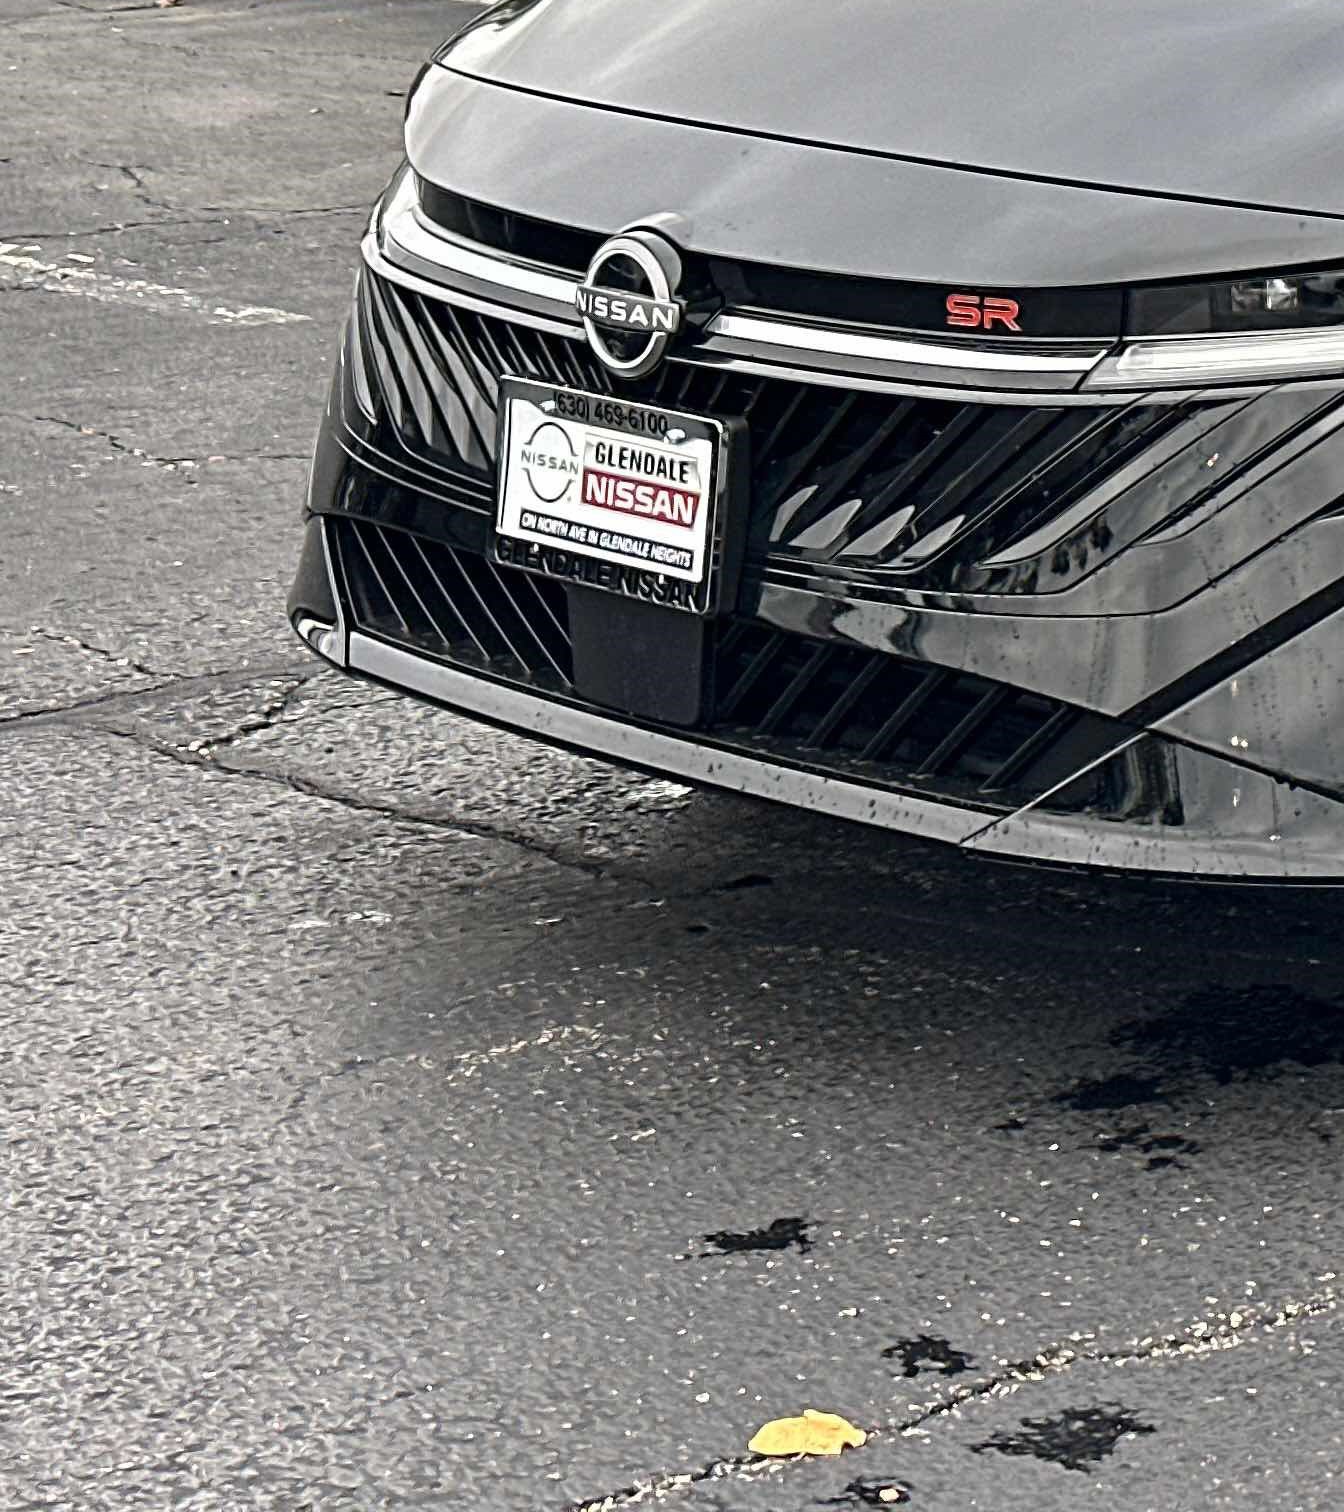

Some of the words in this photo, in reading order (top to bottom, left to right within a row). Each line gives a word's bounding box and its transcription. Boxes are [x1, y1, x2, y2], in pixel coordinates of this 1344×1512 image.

[576, 289, 673, 329] NISSAN
[945, 294, 1021, 332] SR
[594, 401, 668, 436] 469-6100
[521, 449, 579, 475] NISSAN
[594, 441, 689, 484] GLENDALE
[585, 473, 693, 525] NISSAN
[521, 513, 537, 529] ON
[537, 516, 569, 537] NORTH
[569, 525, 588, 543] AVE
[587, 529, 600, 546] IN
[600, 532, 650, 559] GLENDALE
[650, 544, 693, 568] HEIGHTS
